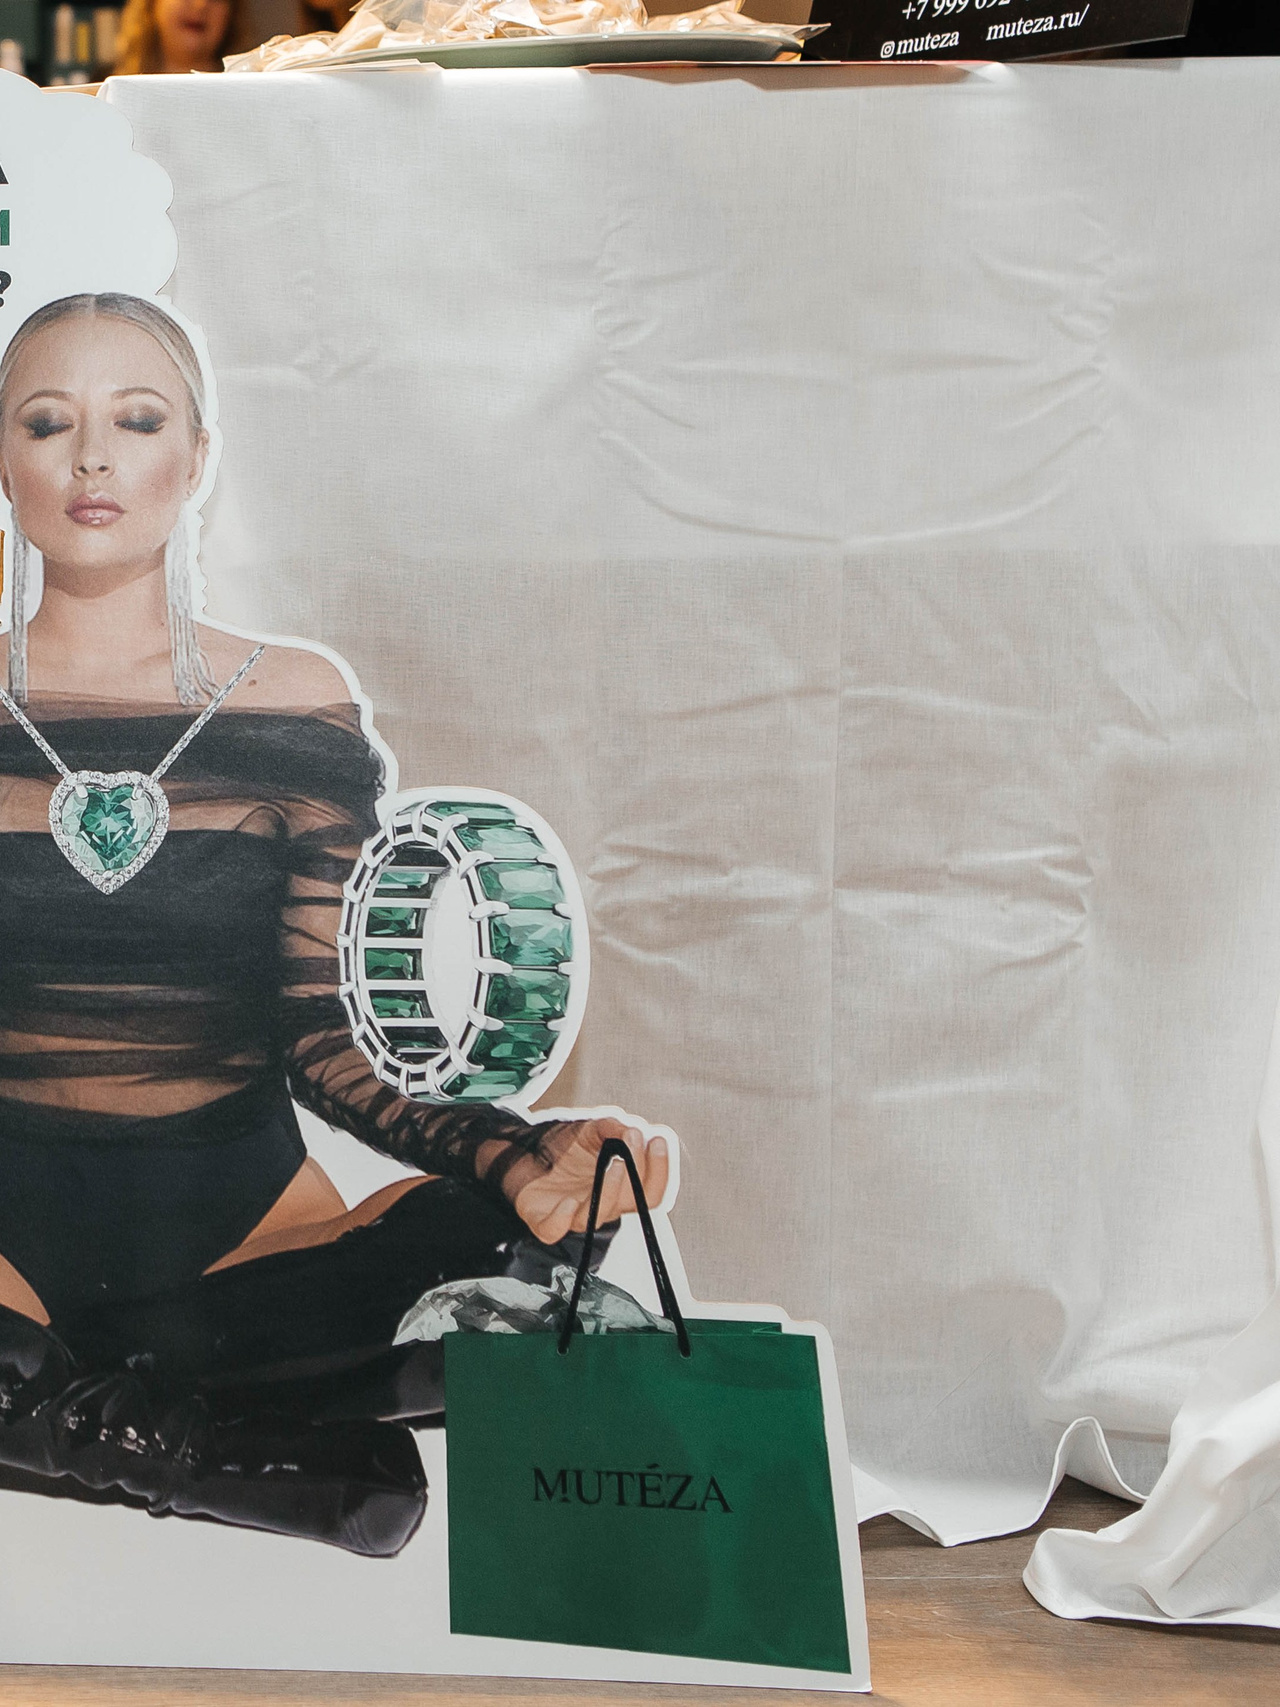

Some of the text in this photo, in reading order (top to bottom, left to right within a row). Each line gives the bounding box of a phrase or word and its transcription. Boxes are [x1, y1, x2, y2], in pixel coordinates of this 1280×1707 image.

[902, 0, 928, 20] +7
[985, 4, 1090, 41] muteza.ru/
[533, 1463, 733, 1513] MUTÉZA
